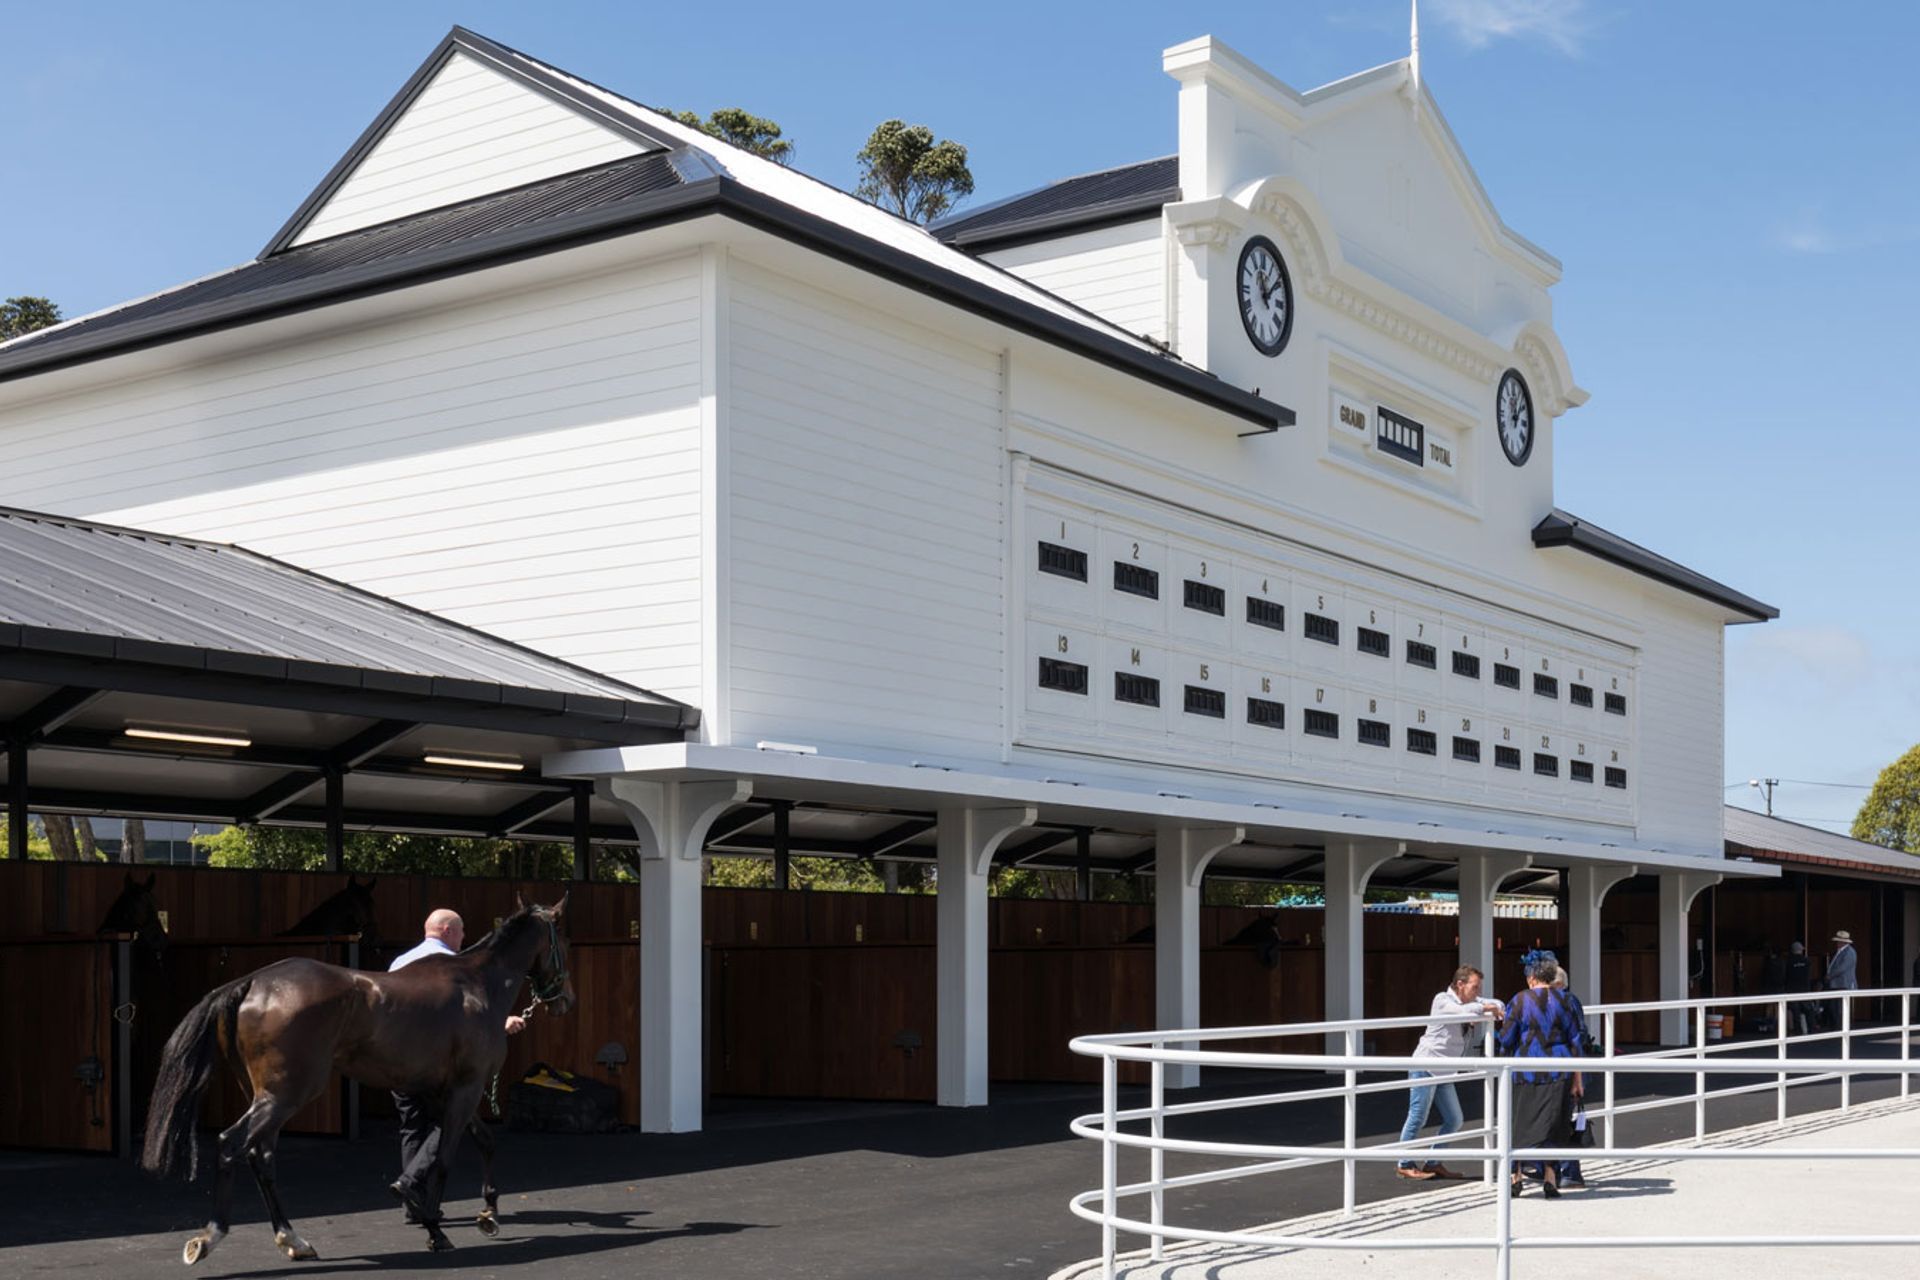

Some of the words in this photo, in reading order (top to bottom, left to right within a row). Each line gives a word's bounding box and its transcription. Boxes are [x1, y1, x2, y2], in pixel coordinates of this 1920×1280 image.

[1340, 405, 1366, 431] GRAND
[1430, 443, 1452, 467] TOTAL
[1132, 542, 1140, 561] 2
[1200, 561, 1207, 579] 3
[1261, 579, 1268, 595] 4
[1317, 595, 1324, 611] 5
[1369, 609, 1376, 625] 6
[1417, 623, 1424, 638] 7
[1057, 635, 1069, 653] 13
[1130, 648, 1141, 666] 14
[1199, 664, 1209, 681] 15
[1316, 689, 1325, 703] 17
[1417, 709, 1426, 723] 19
[1461, 719, 1471, 732] 20
[1502, 727, 1511, 741] 21
[1541, 736, 1550, 748] 22
